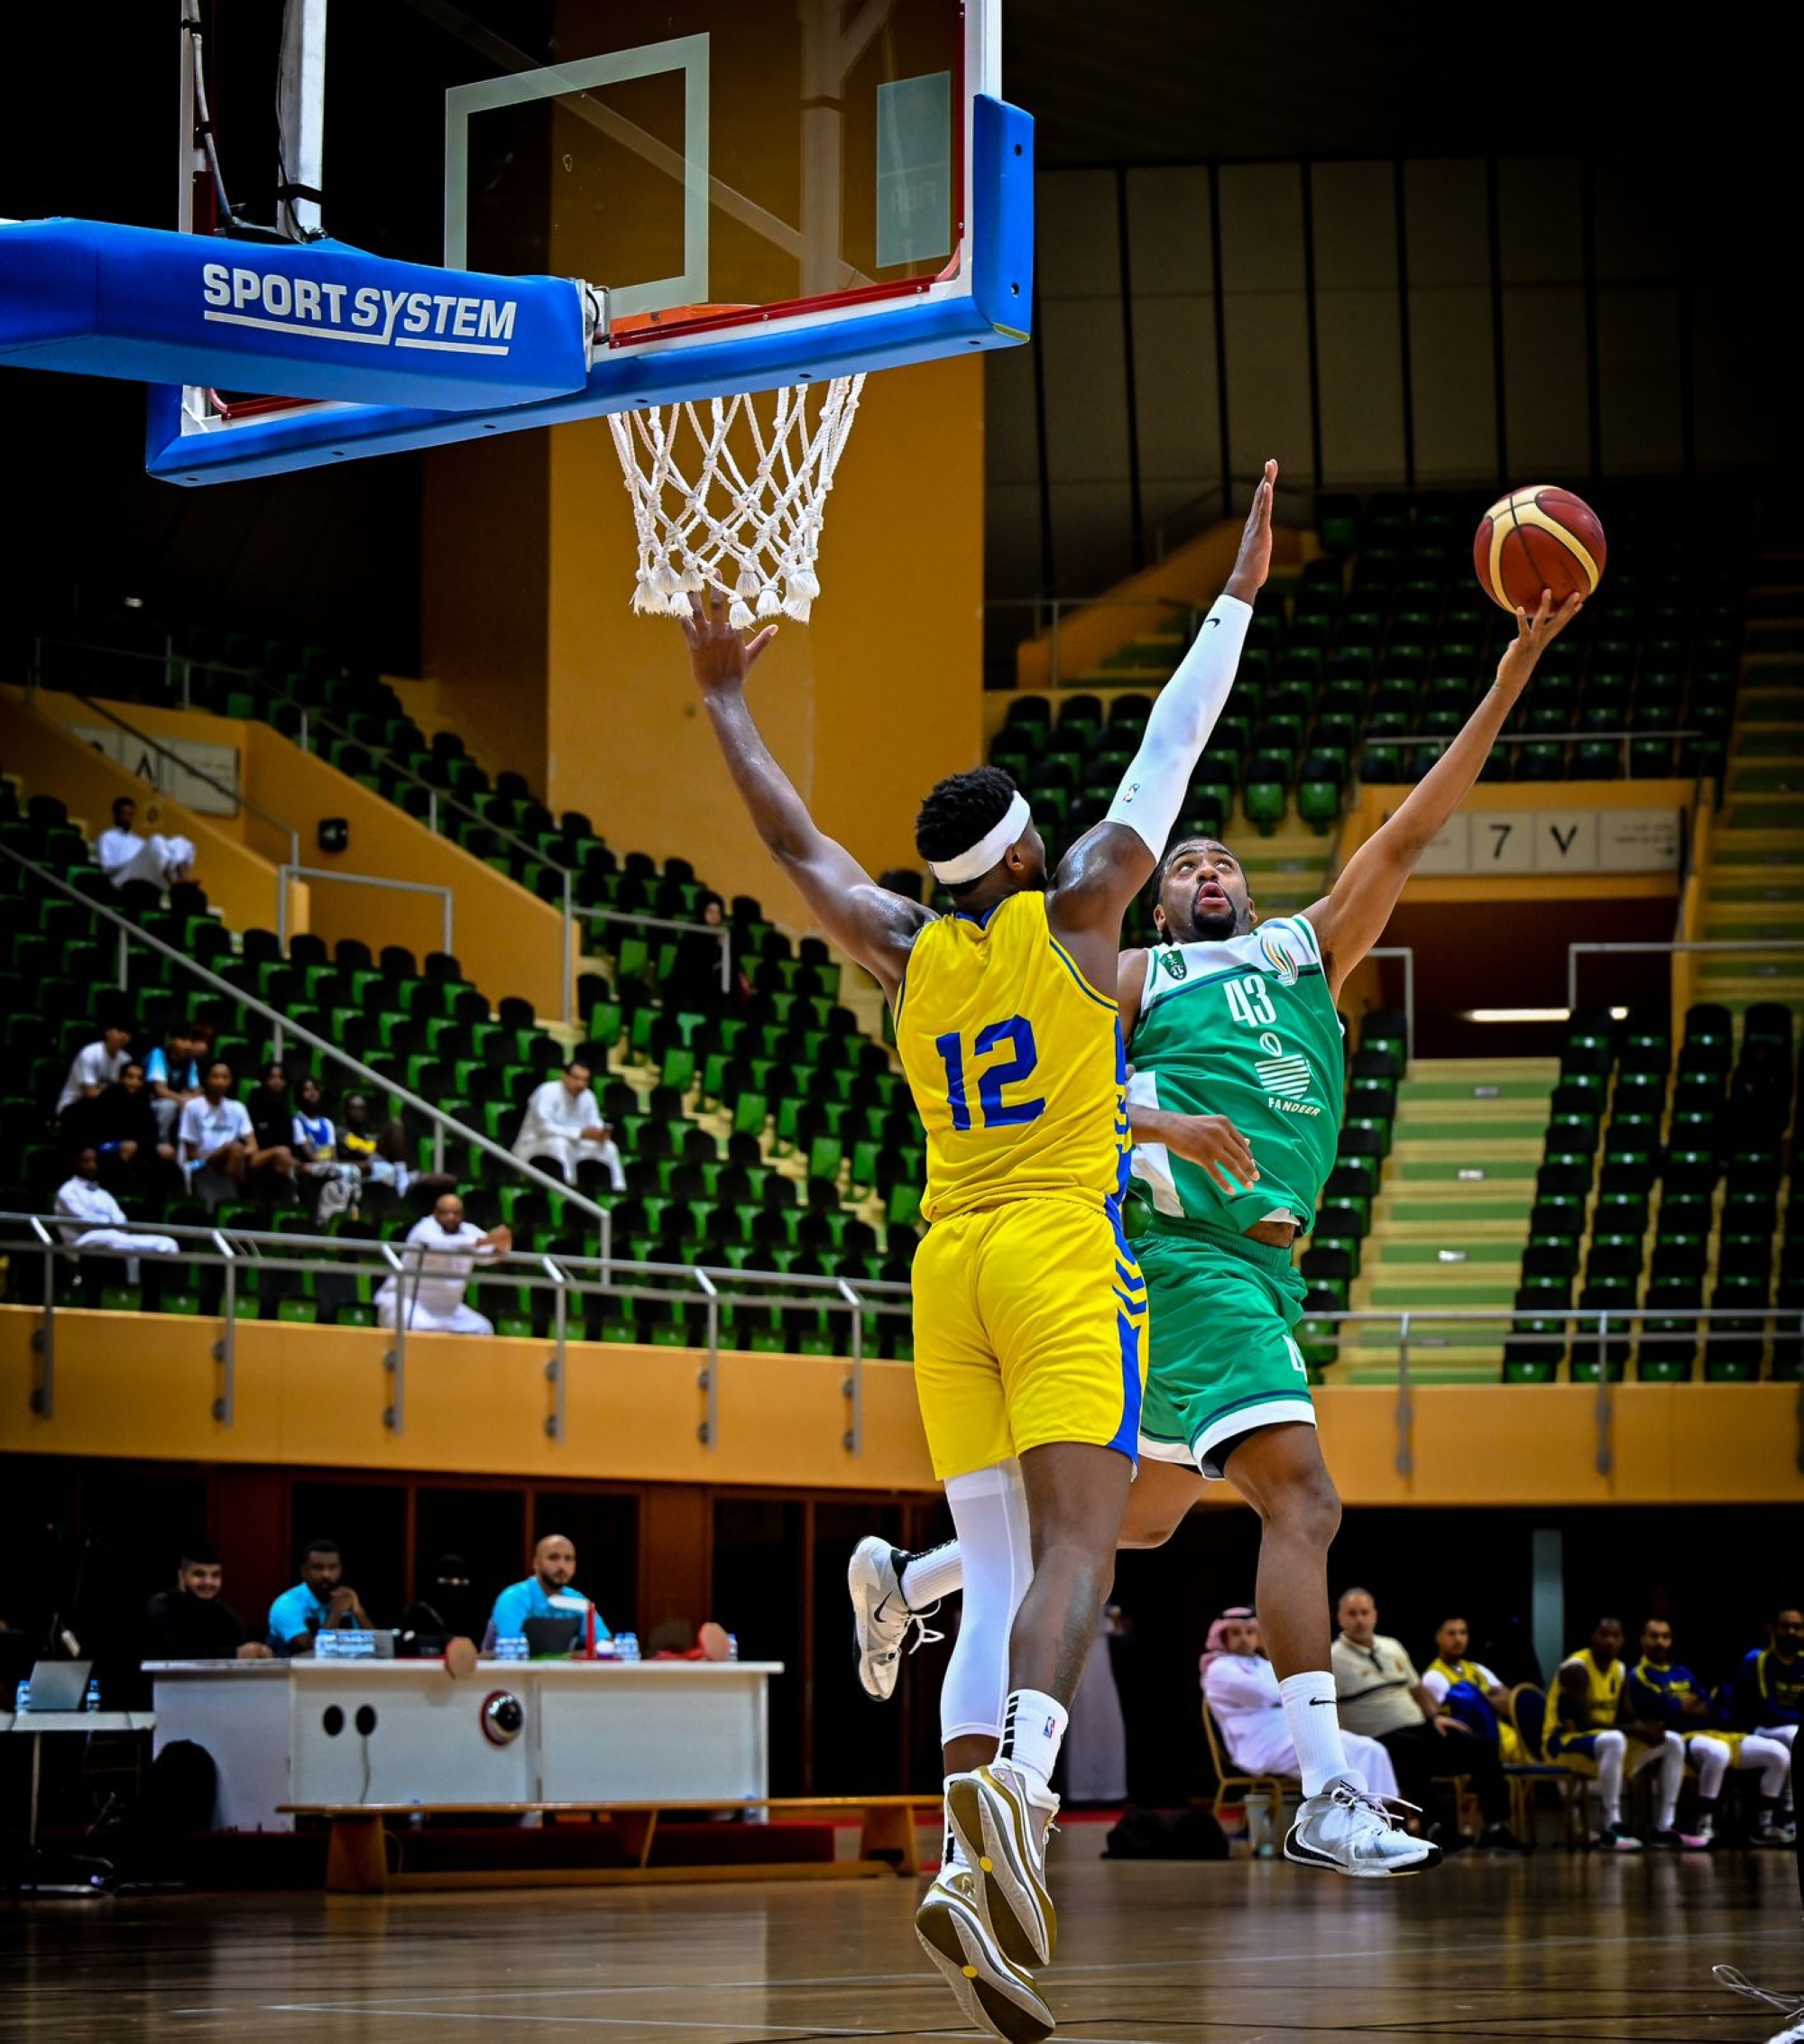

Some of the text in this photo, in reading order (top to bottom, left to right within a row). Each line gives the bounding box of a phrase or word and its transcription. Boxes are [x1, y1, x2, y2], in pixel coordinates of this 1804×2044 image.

[203, 263, 518, 343] SPORT SYSTEM
[1490, 824, 1512, 859] 7
[1223, 974, 1277, 1027] 43
[935, 1014, 1046, 1131] 12
[1268, 1097, 1321, 1117] FANDEER
